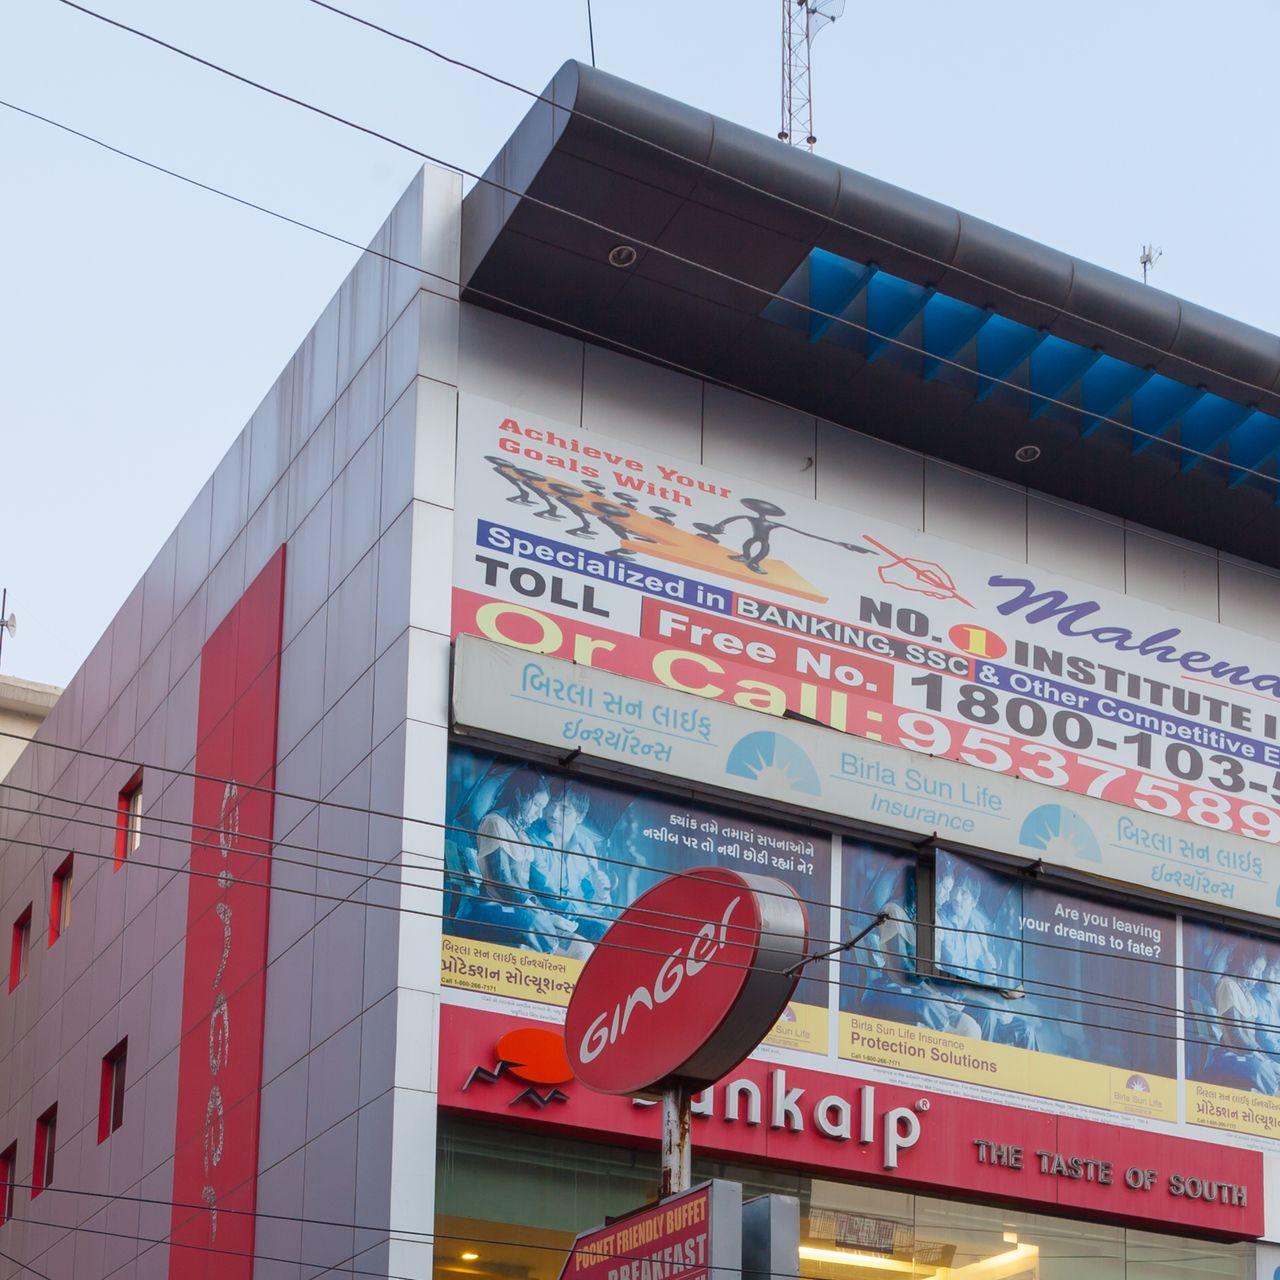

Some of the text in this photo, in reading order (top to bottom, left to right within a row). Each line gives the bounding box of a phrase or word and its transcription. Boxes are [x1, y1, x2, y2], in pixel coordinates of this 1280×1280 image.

[499, 417, 732, 500] Achieve Your
[499, 437, 693, 507] Goals With
[475, 554, 610, 618] TOLL
[659, 609, 776, 665] Free
[796, 647, 878, 691] No.
[475, 602, 617, 667] Or
[487, 526, 684, 599] Specialized
[697, 585, 725, 610] in
[737, 597, 894, 657] BANKING,
[906, 645, 968, 676] SSC
[979, 665, 1000, 686] &
[1009, 672, 1088, 710] Other
[1097, 699, 1255, 759] Competitive
[522, 662, 594, 709] બિરલા
[603, 690, 642, 720] સન
[860, 595, 942, 643] NO.
[1014, 639, 1251, 733] INSTITUTE
[841, 752, 1003, 812] Birla Sun Life
[871, 793, 975, 834] Insurance
[1116, 816, 1175, 851] બિરલા
[1180, 838, 1210, 861] સન
[1019, 915, 1161, 959] your dreams to fate?
[1055, 903, 1161, 943] Are you leaving
[851, 1019, 964, 1050] Birla Sun Life Insurance
[851, 1031, 998, 1073] Protection Solutions
[974, 1139, 1247, 1208] THE TASTE OF SOUTH
[575, 1196, 707, 1272] POCKET FRIENDLY BUFFET
